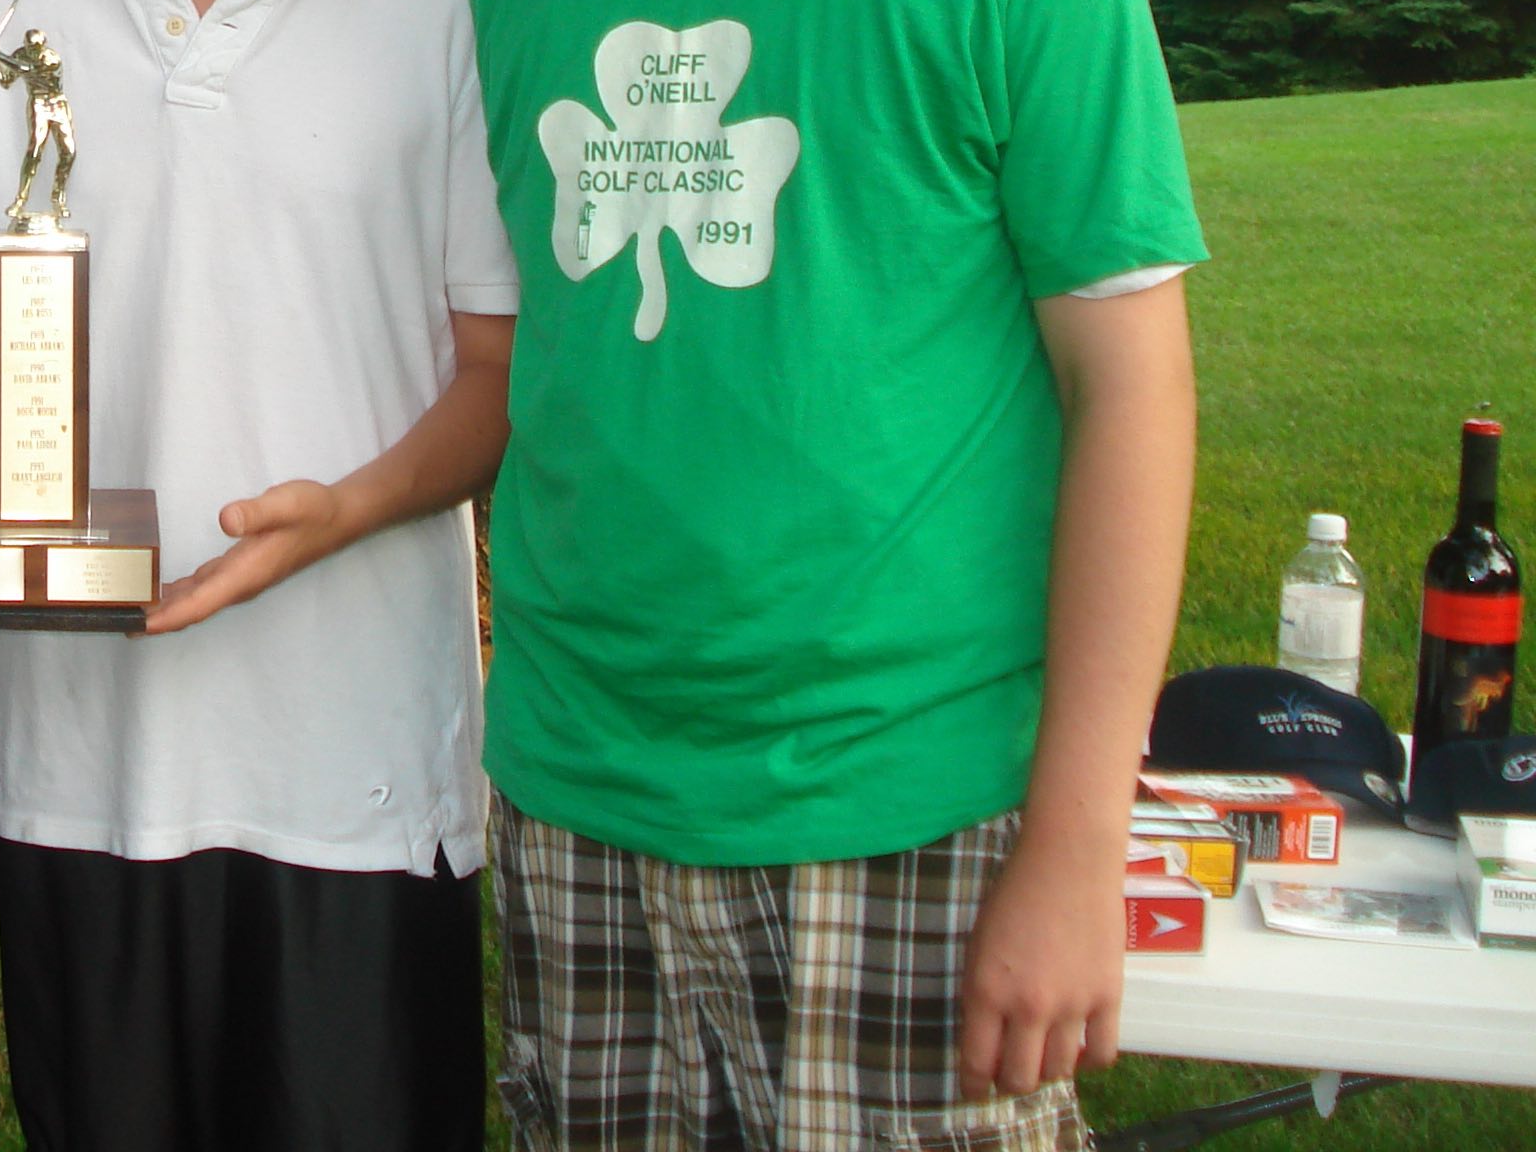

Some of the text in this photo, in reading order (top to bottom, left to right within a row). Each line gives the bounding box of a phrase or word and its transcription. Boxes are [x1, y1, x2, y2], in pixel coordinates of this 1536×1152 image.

[641, 54, 706, 76] CLIFF
[626, 79, 716, 106] O'NEILL
[584, 139, 734, 163] INVITATIONAL
[577, 169, 744, 193] GOLF CLASSIC
[696, 221, 753, 245] 1991
